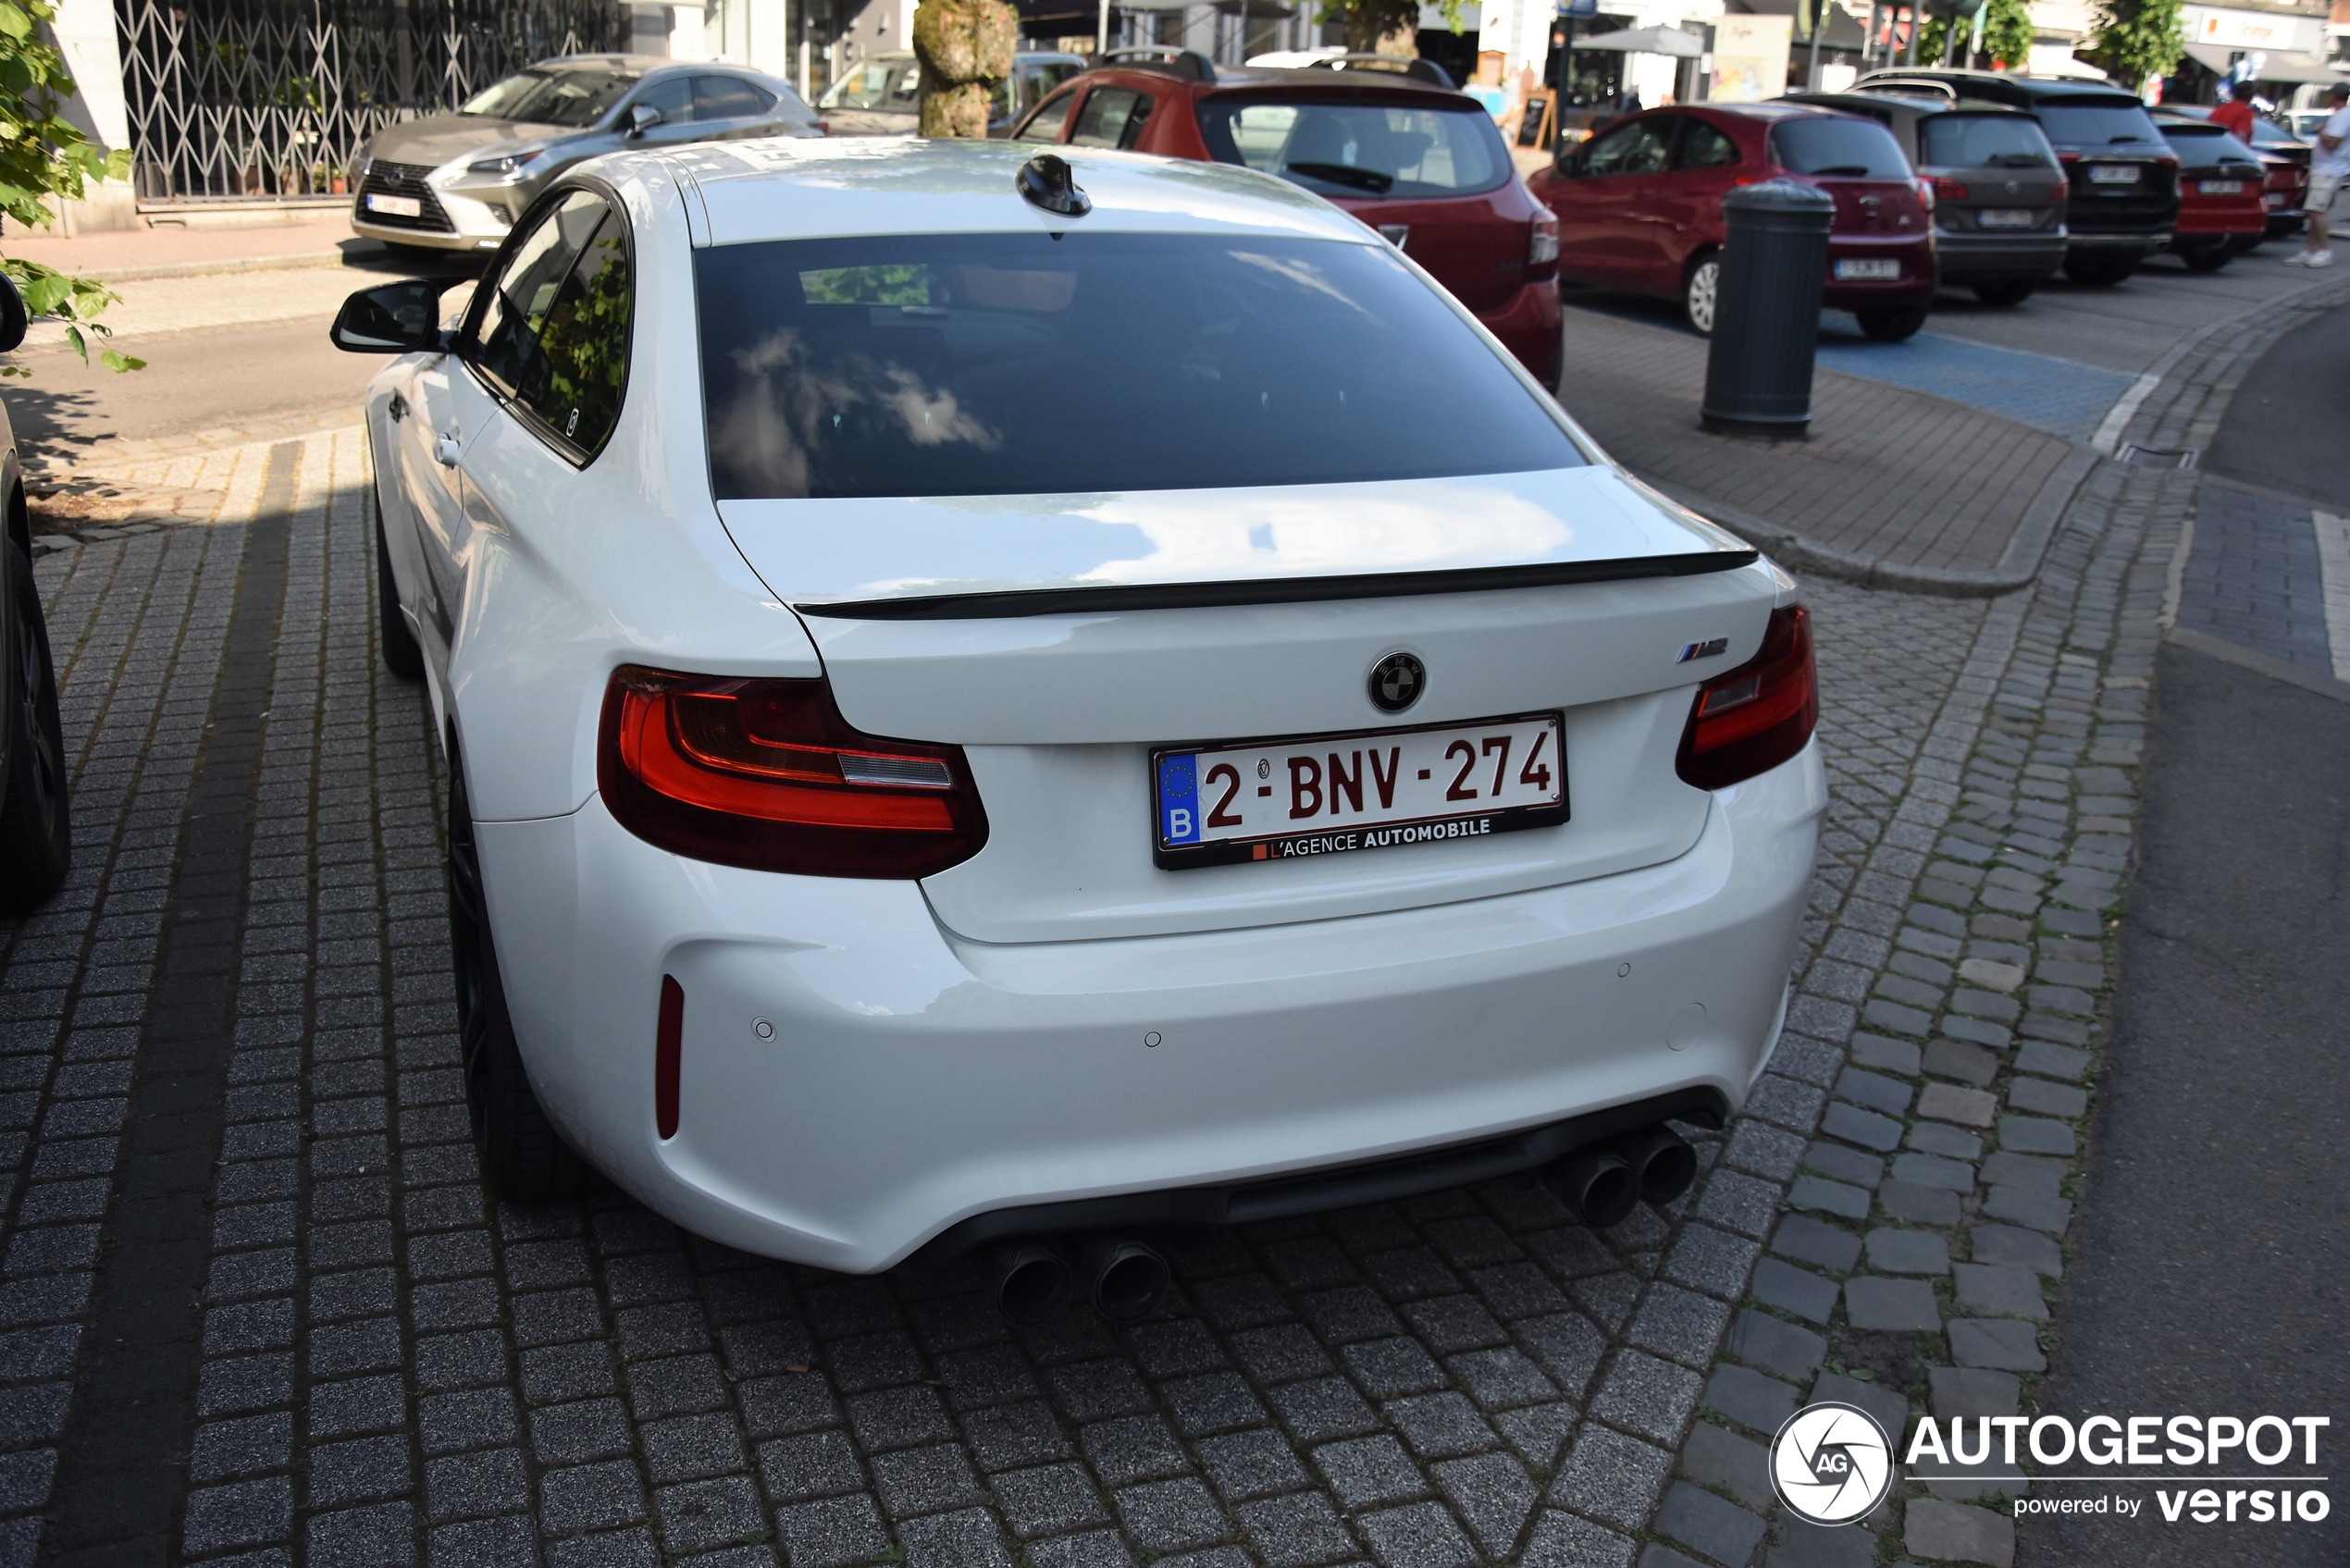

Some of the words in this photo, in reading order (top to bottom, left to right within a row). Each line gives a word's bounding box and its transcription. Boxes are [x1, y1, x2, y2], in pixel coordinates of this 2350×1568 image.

[1378, 657, 1420, 675] BMW
[1205, 732, 1552, 828] 2-BNV-274
[1169, 809, 1193, 839] B
[1270, 834, 1357, 858] L'AGENCE
[1364, 819, 1490, 848] AUTOMOBILE
